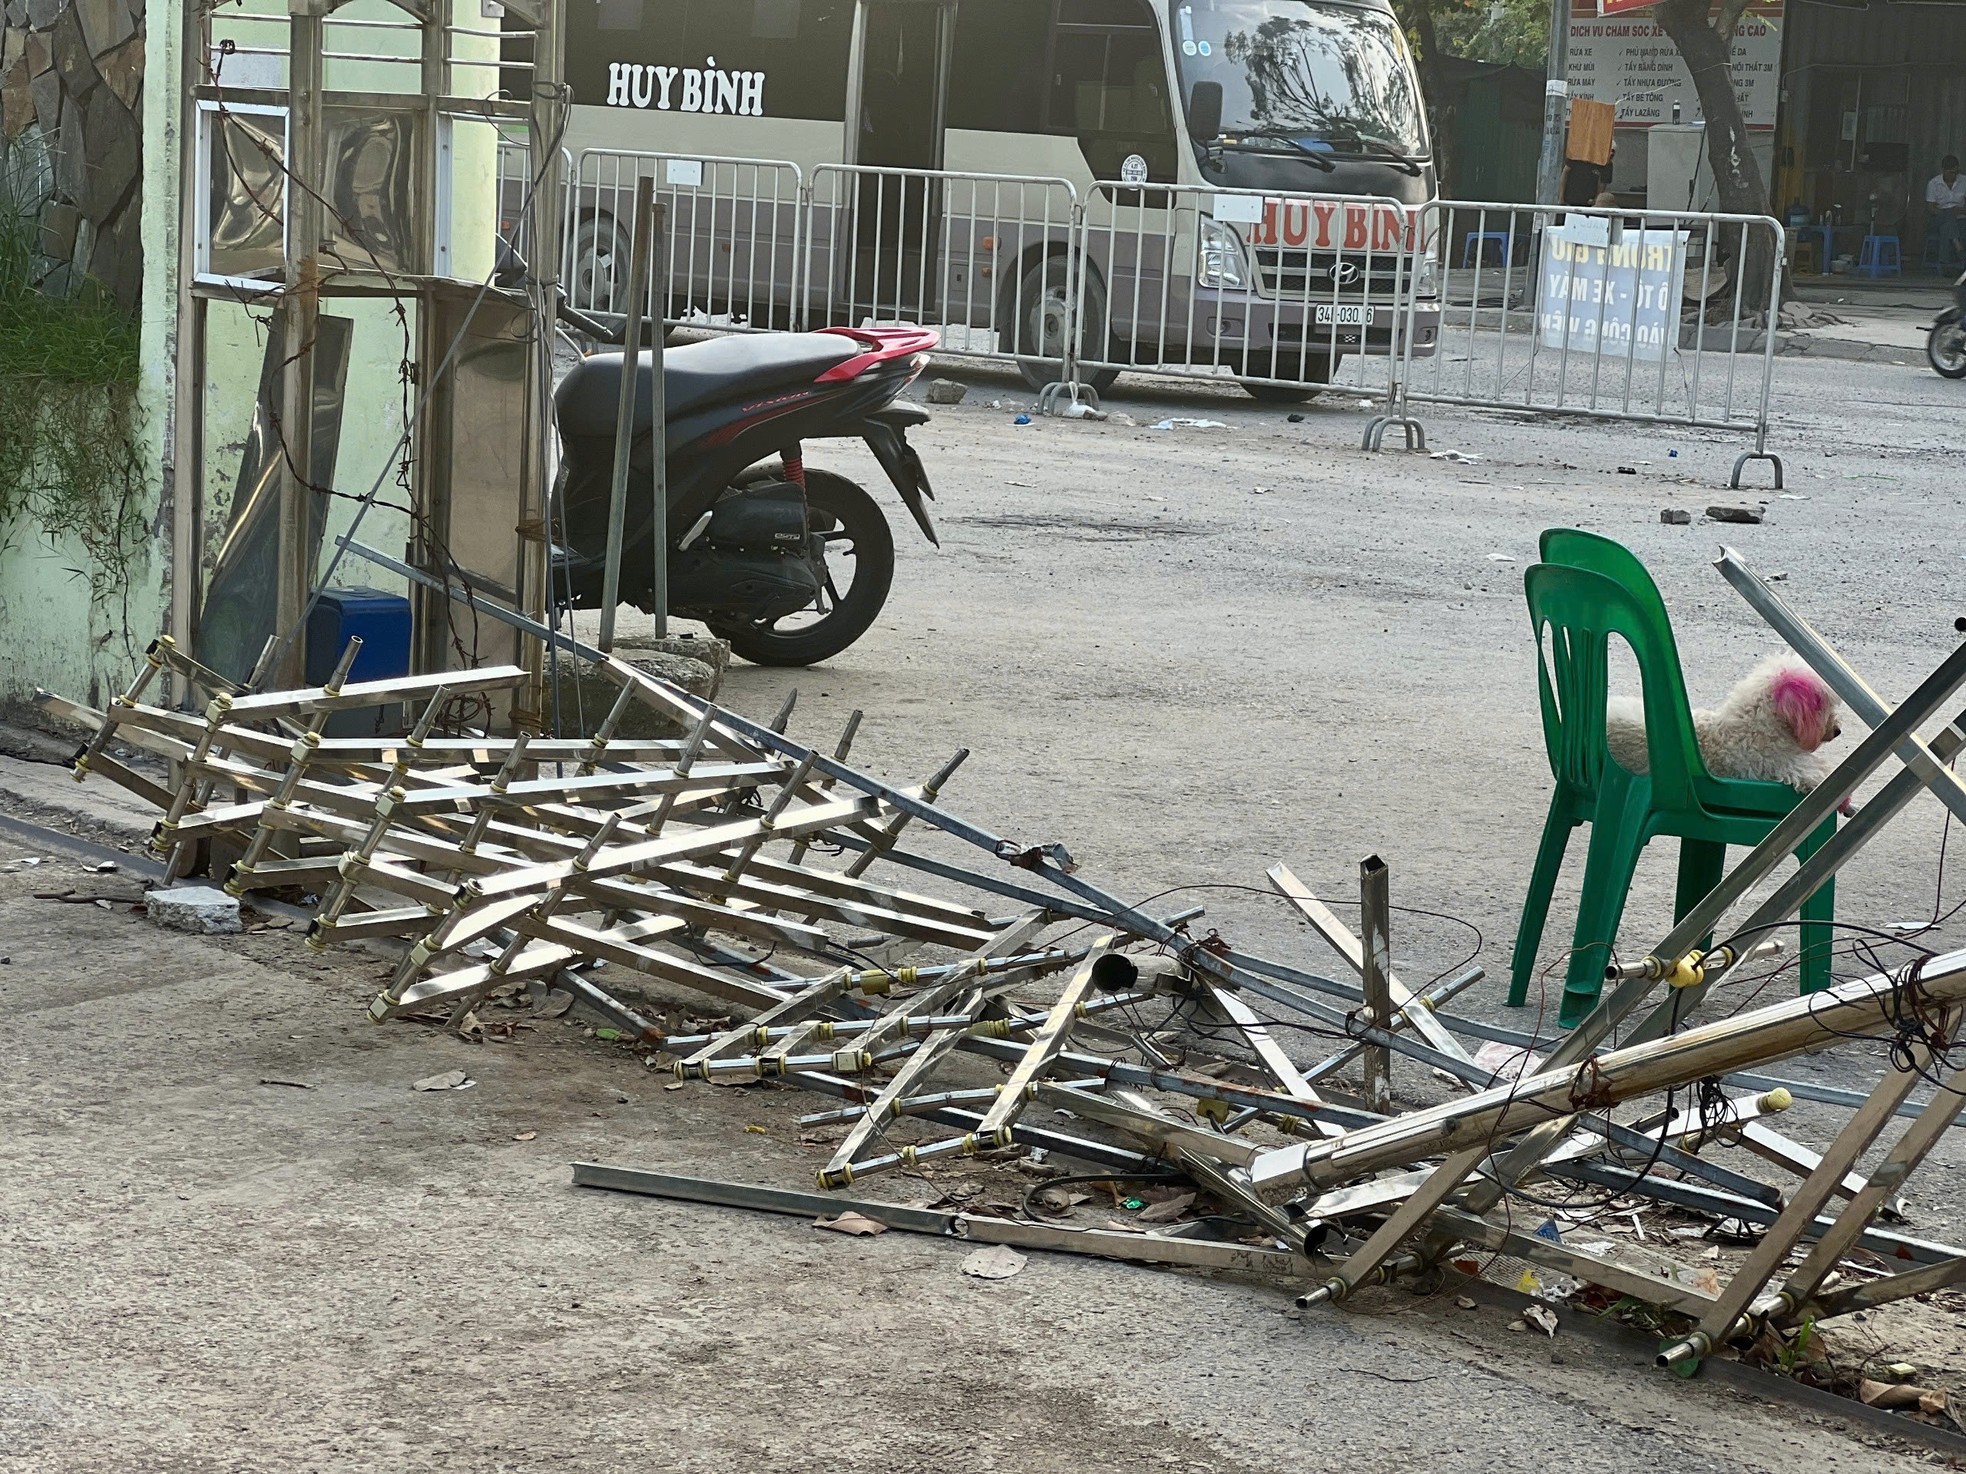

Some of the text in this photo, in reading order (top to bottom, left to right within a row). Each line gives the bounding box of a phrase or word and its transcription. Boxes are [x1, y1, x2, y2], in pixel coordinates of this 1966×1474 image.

[1747, 25, 1767, 37] CAO
[1584, 48, 1593, 56] XE
[1737, 48, 1747, 56] DA
[1763, 64, 1773, 72] 3M
[606, 56, 766, 116] HUY BÌNH
[1246, 198, 1336, 248] HUY
